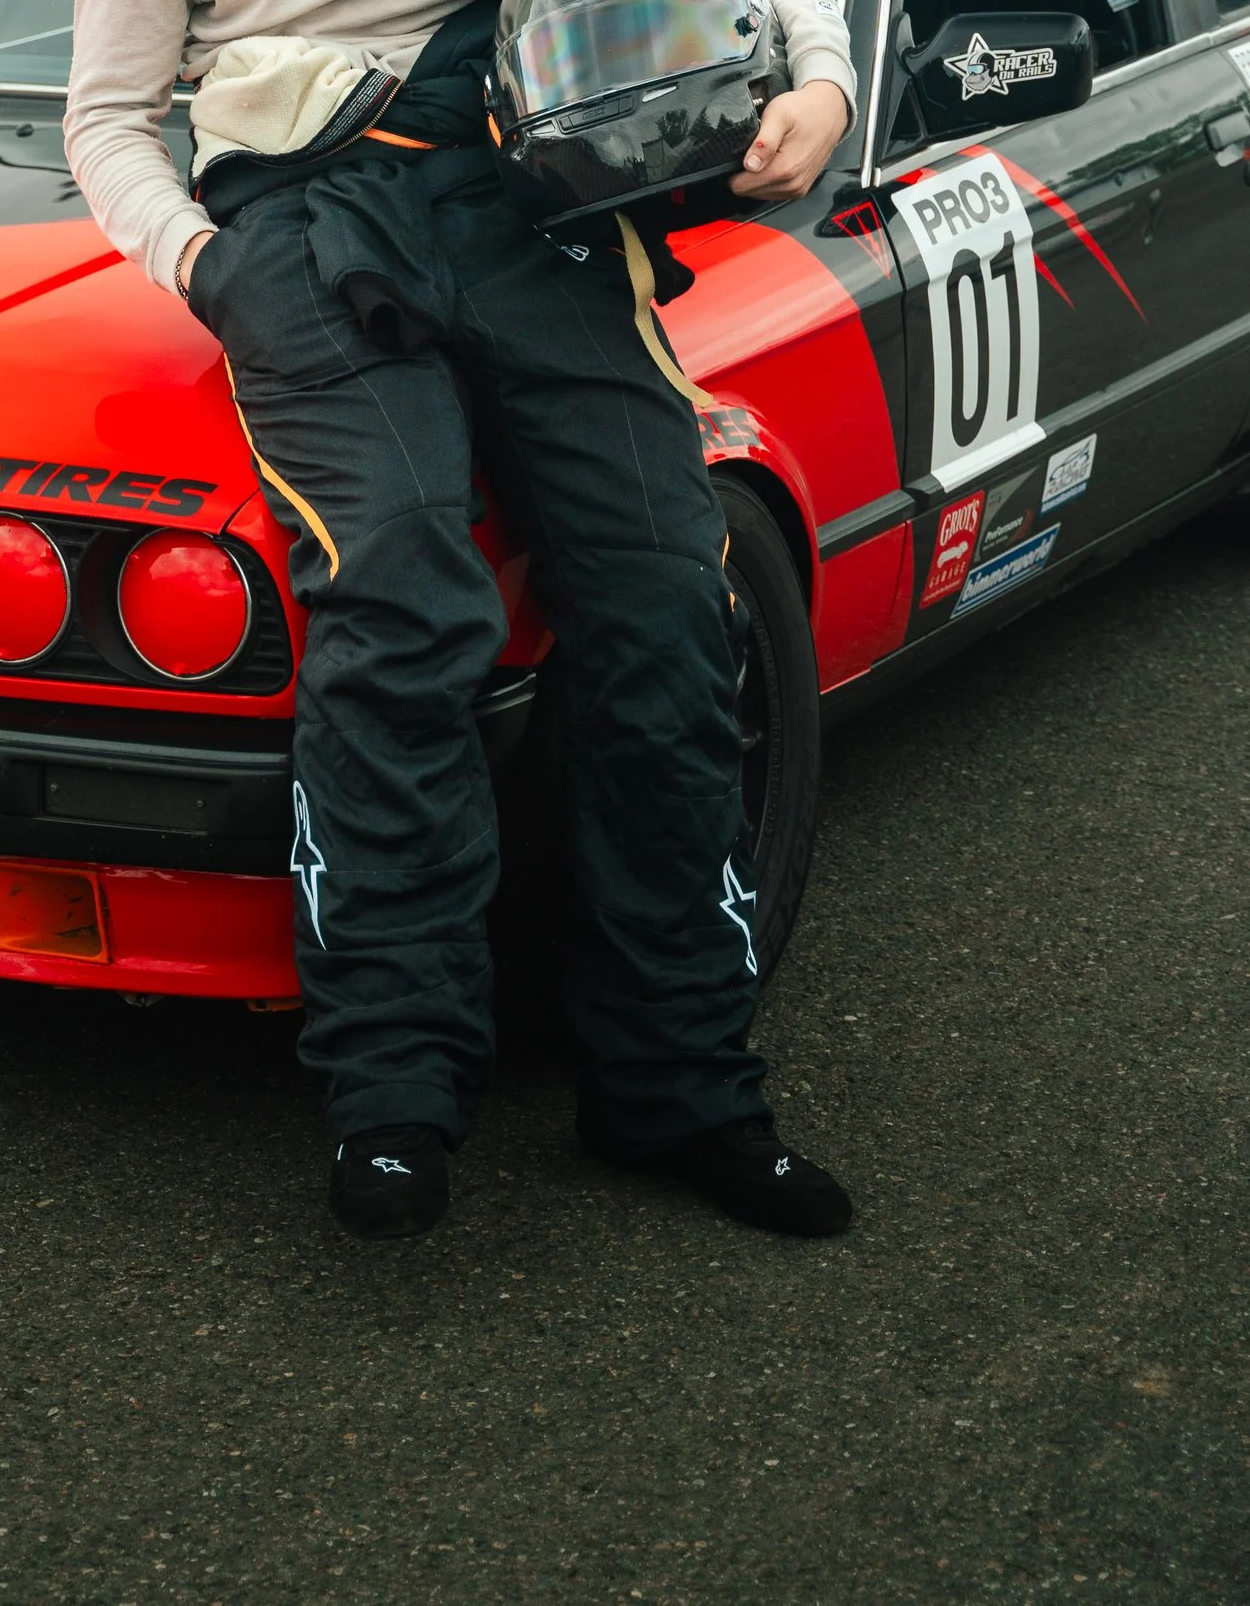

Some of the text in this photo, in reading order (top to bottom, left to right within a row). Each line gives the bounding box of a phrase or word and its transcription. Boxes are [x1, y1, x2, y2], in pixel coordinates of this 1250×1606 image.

[994, 52, 1049, 72] RACER
[1017, 63, 1053, 79] RAILS
[912, 171, 1010, 245] PRO3
[946, 230, 1021, 447] 01
[940, 499, 980, 547] GRIOT'S
[928, 561, 967, 589] GARAGE
